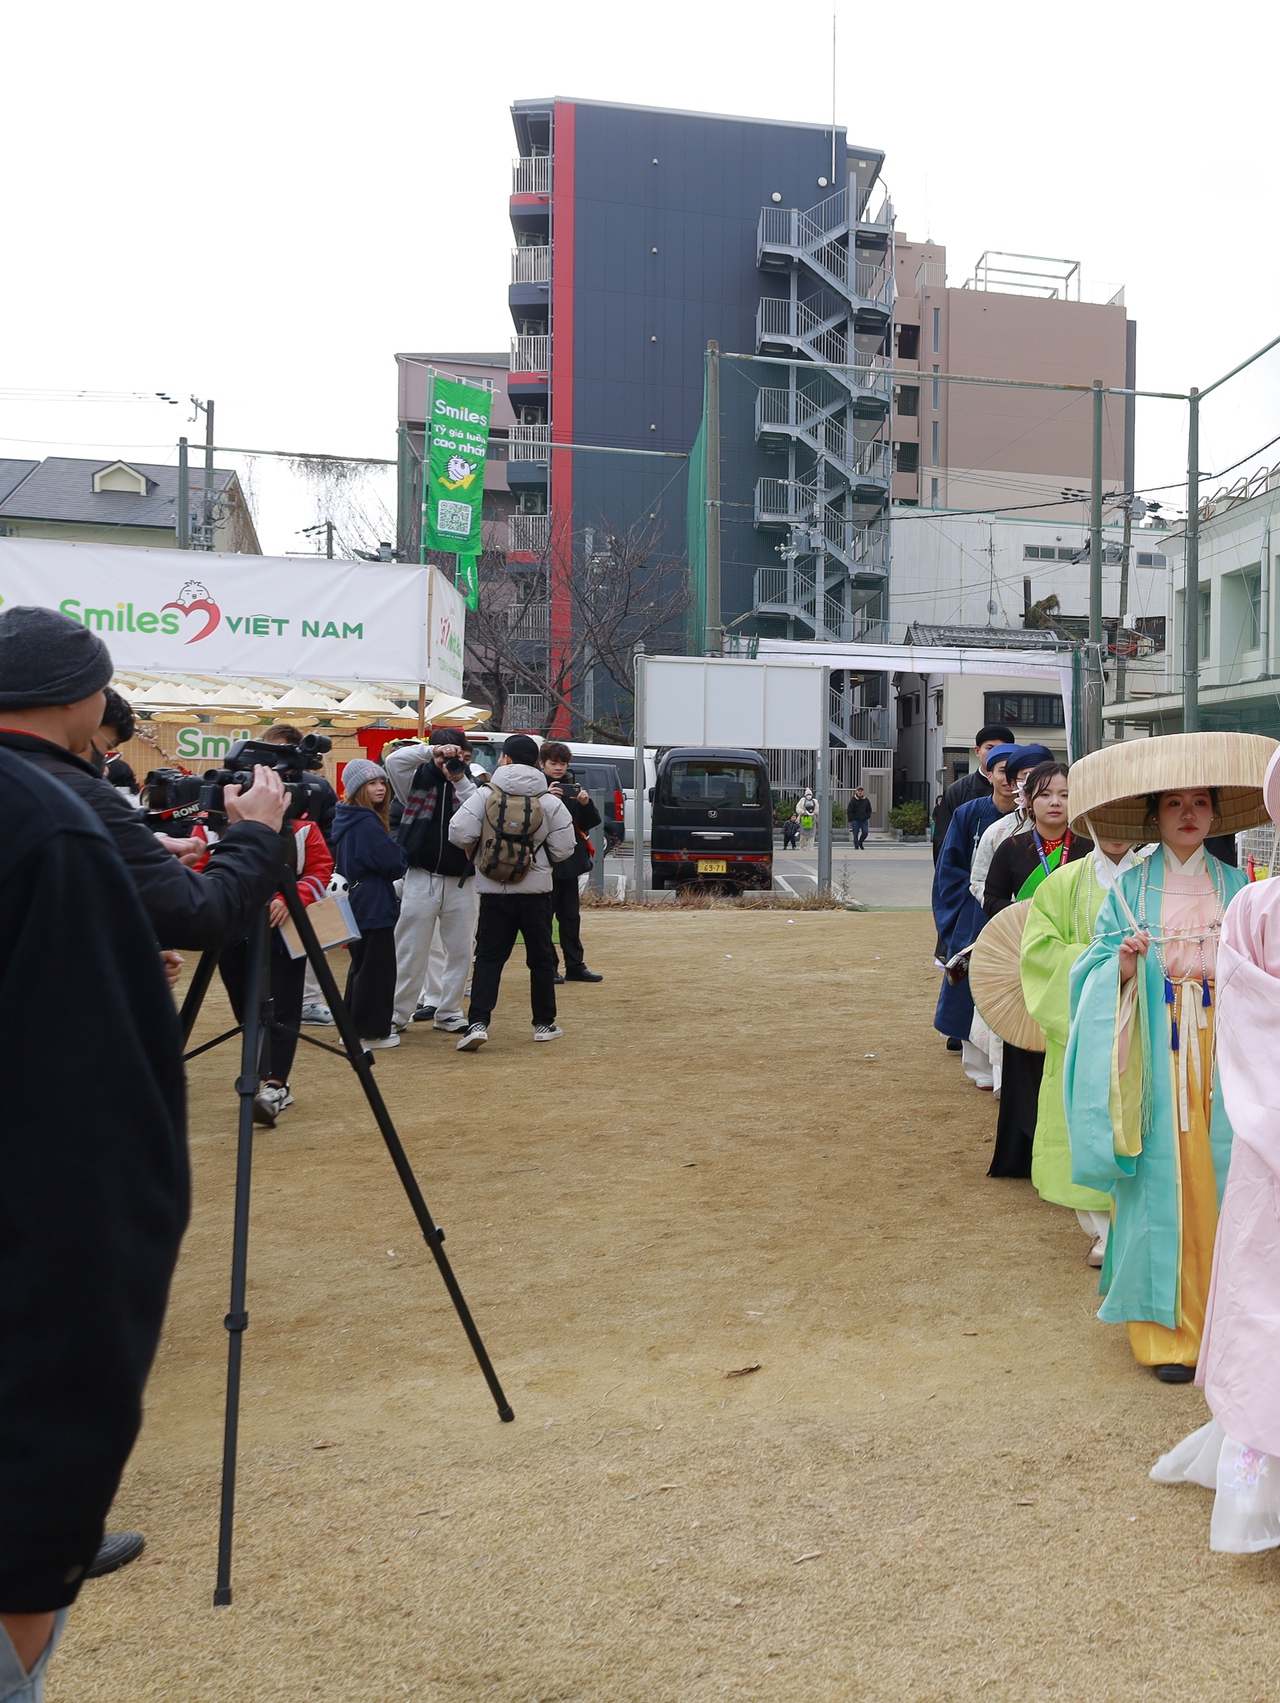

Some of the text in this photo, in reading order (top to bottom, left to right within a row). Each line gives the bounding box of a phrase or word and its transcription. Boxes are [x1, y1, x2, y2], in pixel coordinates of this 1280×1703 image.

[435, 399, 488, 427] Smiles
[449, 429, 464, 438] giá
[466, 432, 486, 444] luôn
[433, 438, 485, 457] cao nhất
[59, 599, 363, 640] Smiles VIỆT NAM
[172, 803, 200, 818] RONI
